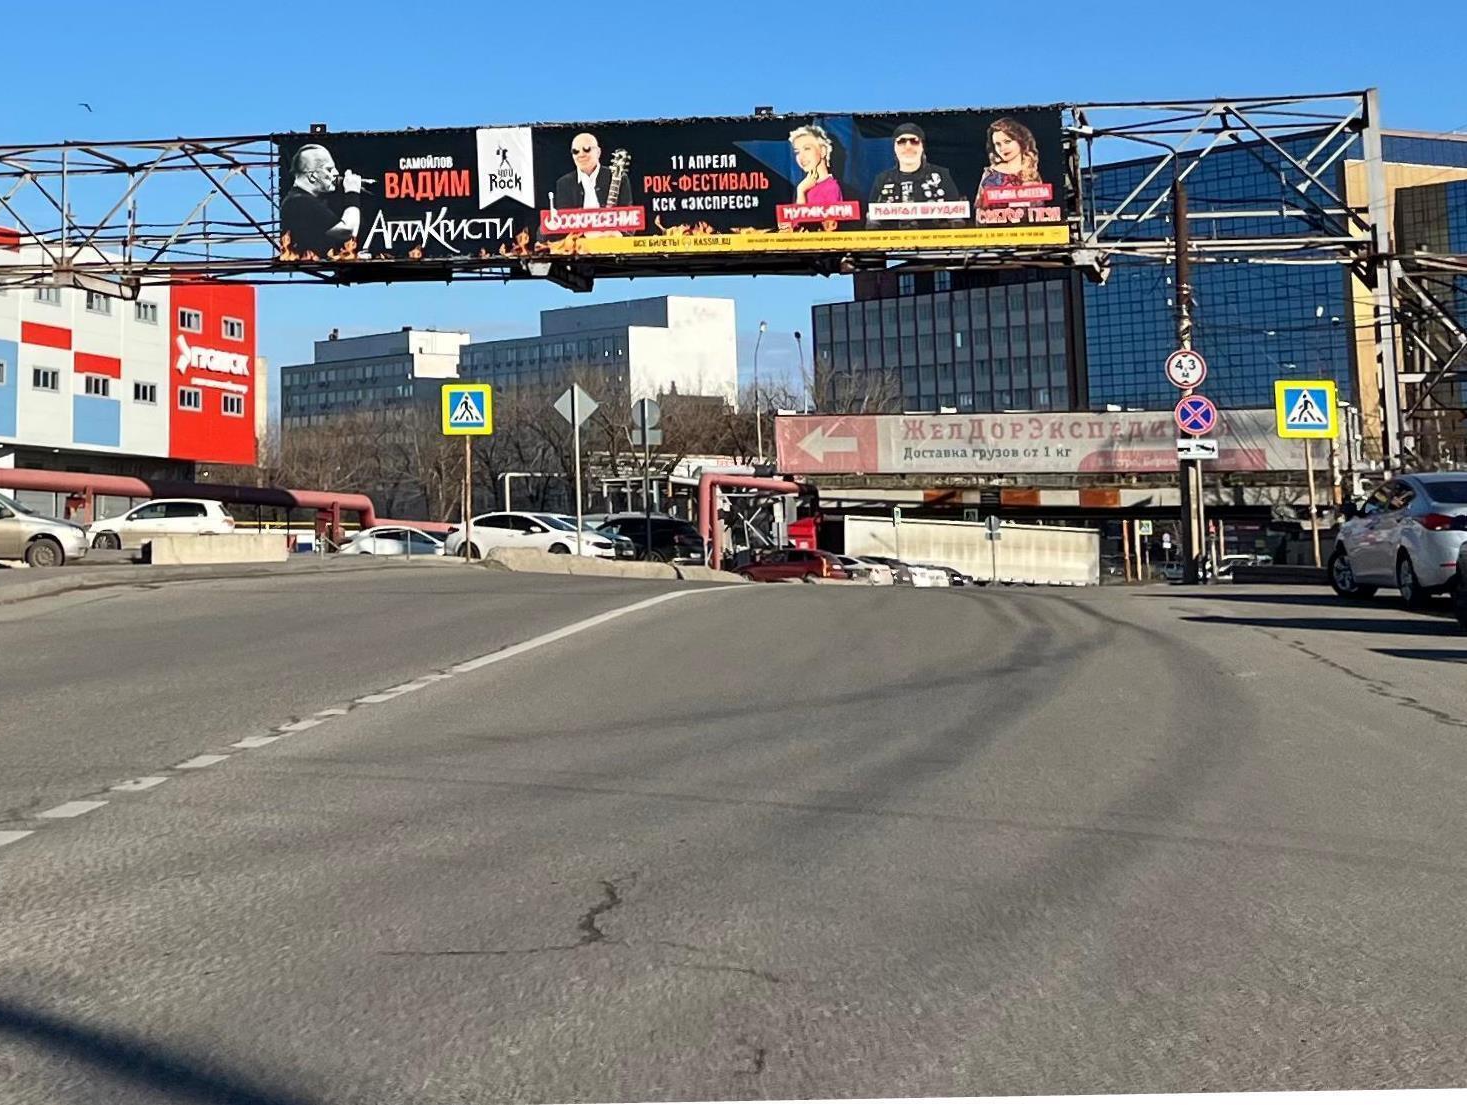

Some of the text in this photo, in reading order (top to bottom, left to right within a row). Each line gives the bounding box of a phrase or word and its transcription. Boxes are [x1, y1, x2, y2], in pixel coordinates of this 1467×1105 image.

[399, 154, 454, 170] САМОЙЛОВ
[670, 154, 737, 170] 11 АПРЕЛЯ
[384, 169, 471, 202] ВАДИМ
[643, 171, 769, 193] РОК-ФЕСТИВАЛЬ
[652, 194, 760, 211] КСК «ЭКСПРЕСС»
[903, 446, 1072, 462] Доставка грузов от 1 кг
